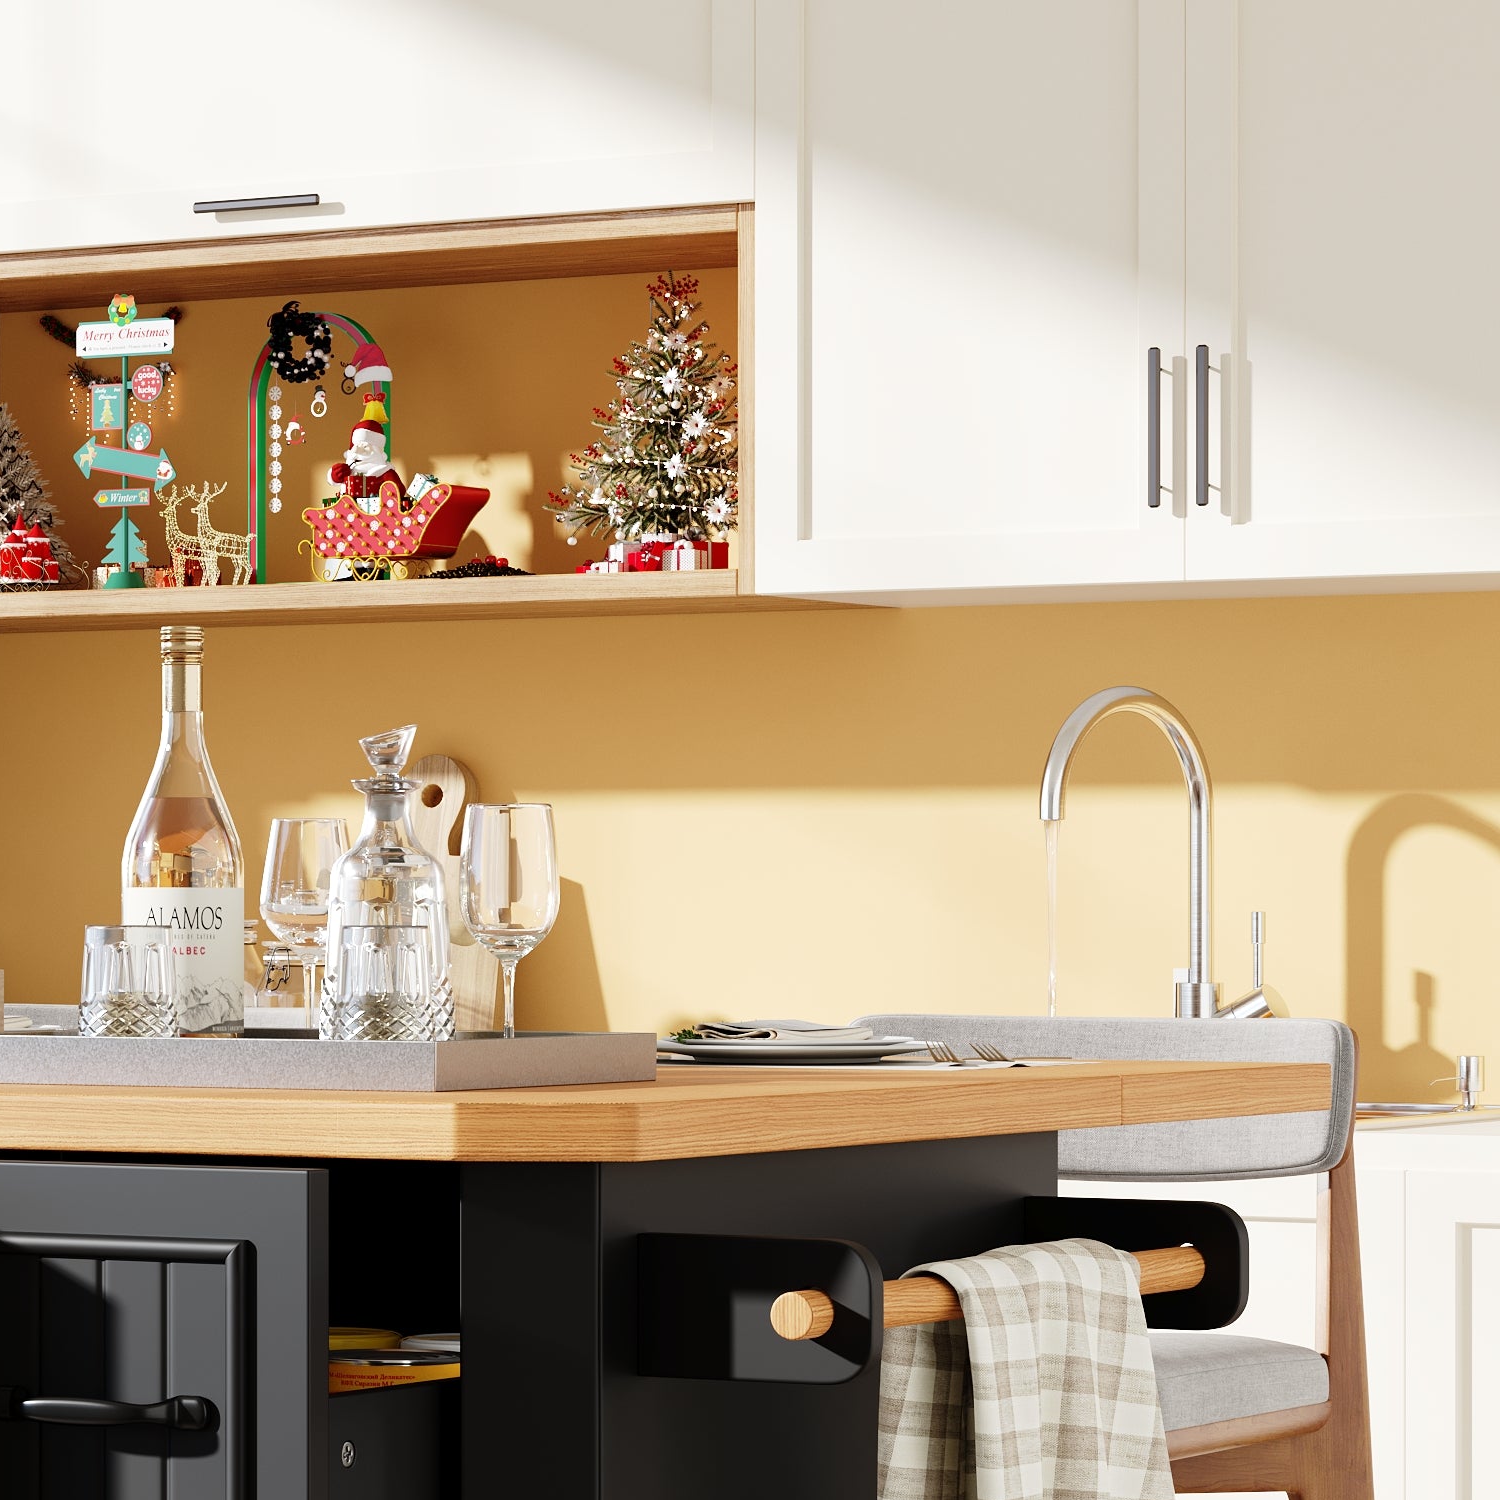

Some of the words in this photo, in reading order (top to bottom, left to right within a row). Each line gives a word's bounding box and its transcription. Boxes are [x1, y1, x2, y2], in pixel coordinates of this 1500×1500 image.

[82, 331, 114, 343] Merry
[118, 327, 170, 340] Christmas
[137, 370, 157, 380] good
[137, 385, 157, 395] lucky
[110, 493, 137, 503] Winter
[146, 906, 223, 930] ALAMOS
[172, 946, 206, 955] ALBEC
